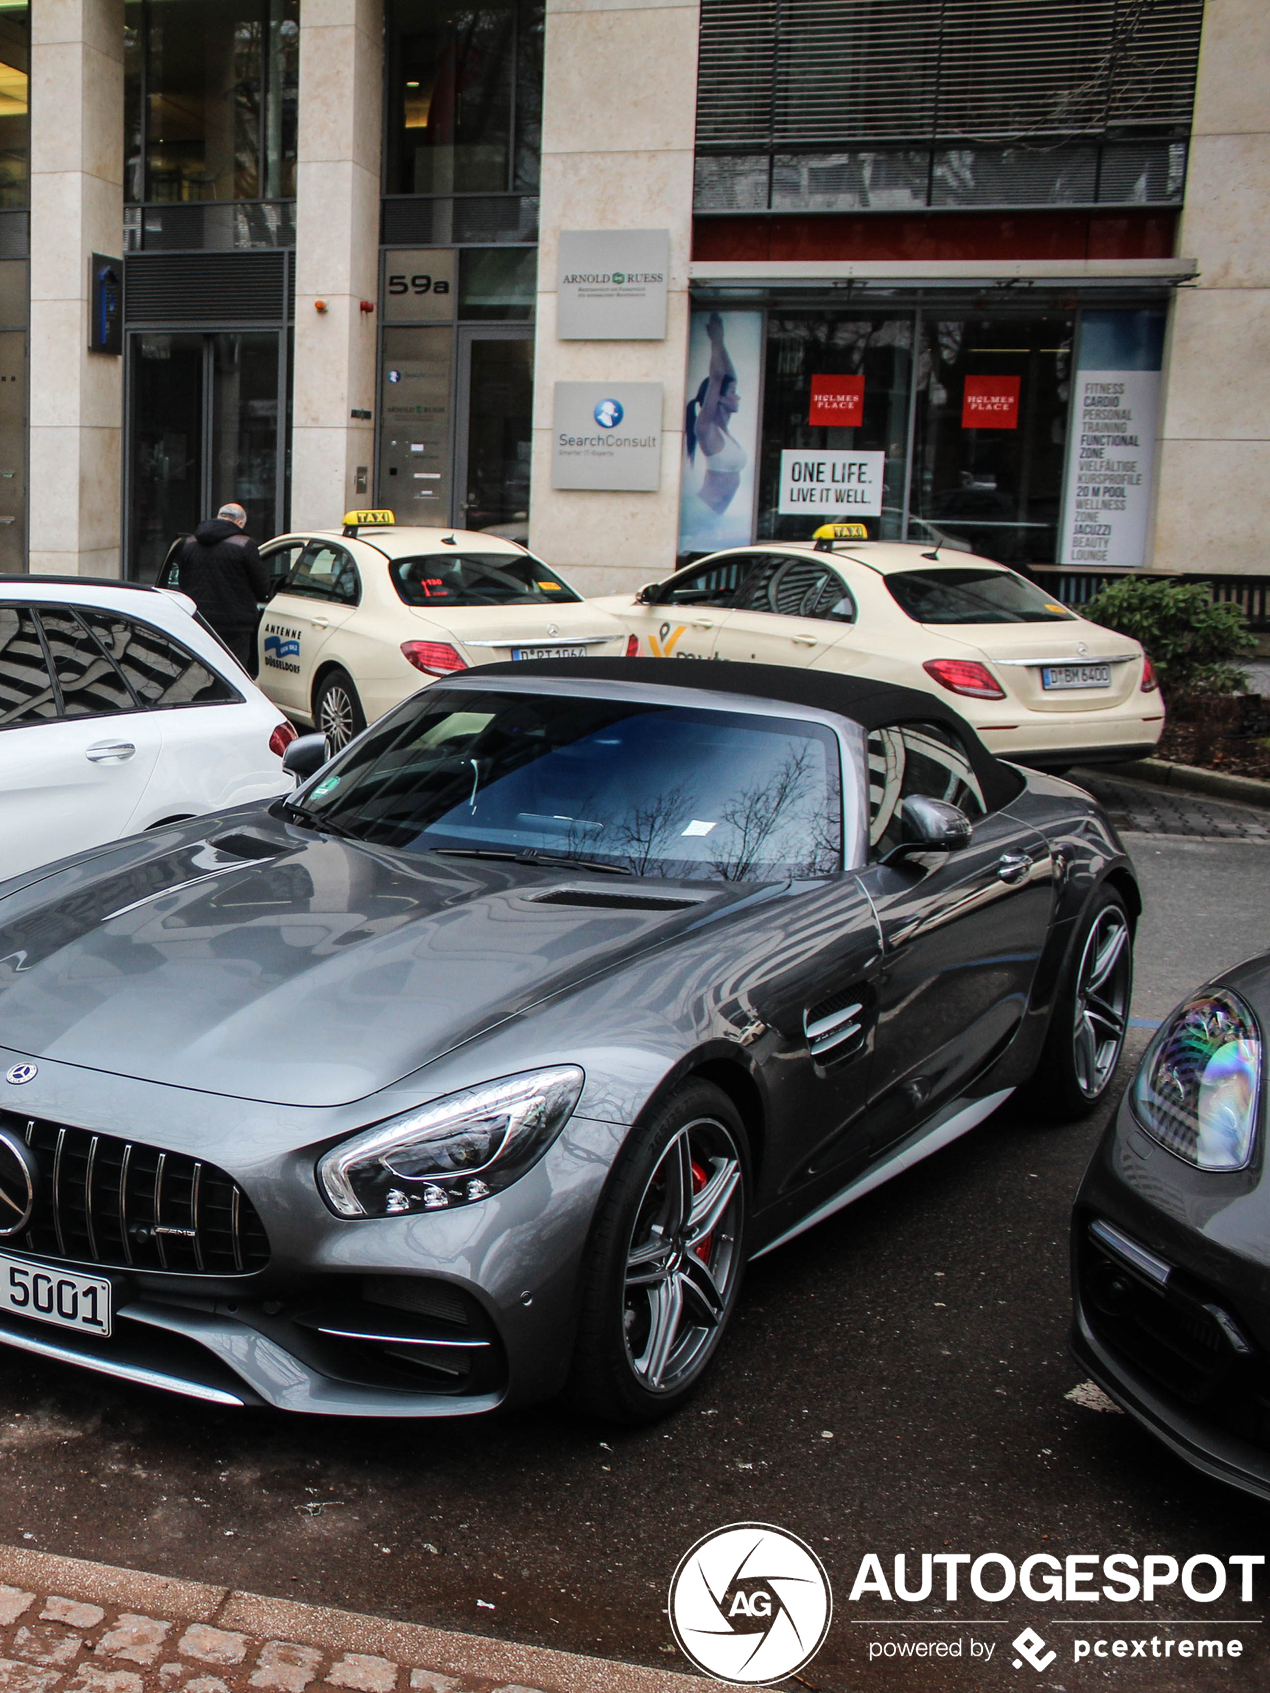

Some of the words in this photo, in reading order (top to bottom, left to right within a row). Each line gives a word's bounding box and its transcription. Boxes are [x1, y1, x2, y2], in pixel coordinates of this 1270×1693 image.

[389, 274, 450, 295] 59a
[562, 273, 611, 284] ARNOLD
[627, 273, 664, 283] RUESS
[1085, 383, 1125, 394] FITNESS
[813, 394, 860, 402] HOLMES
[967, 395, 1015, 403] HOLMES
[1083, 395, 1120, 407] CARDIO
[971, 403, 1010, 411] PLACE
[1082, 409, 1133, 420] PERSONAL
[1082, 422, 1127, 433] TRAINING
[559, 433, 656, 447] SearchConsult
[1080, 434, 1141, 446] FUNCTIONAL
[1079, 447, 1105, 459] ZONE
[791, 461, 827, 482] ONE
[832, 462, 872, 484] LIFE.
[1077, 473, 1142, 485] KURSPROFILE
[790, 487, 817, 502] LIVE
[820, 488, 832, 502] IT
[835, 488, 871, 504] WELL.
[1077, 486, 1089, 497] 20
[1091, 487, 1101, 497] M
[1103, 487, 1127, 498] POOL
[1076, 499, 1126, 510] WELLNESS
[358, 512, 389, 523] TAXI
[1074, 511, 1099, 522] ZONE
[834, 526, 863, 537] TAXI
[1073, 524, 1112, 536] JACUZZI
[1072, 537, 1109, 549] BEAUTY
[1071, 549, 1108, 561] LOUNGE
[265, 623, 302, 640] ANTENNE
[265, 655, 301, 674] DÜSSELDORF
[1050, 670, 1058, 683] D
[1082, 667, 1109, 682] 6400
[9, 1266, 104, 1326] 5001
